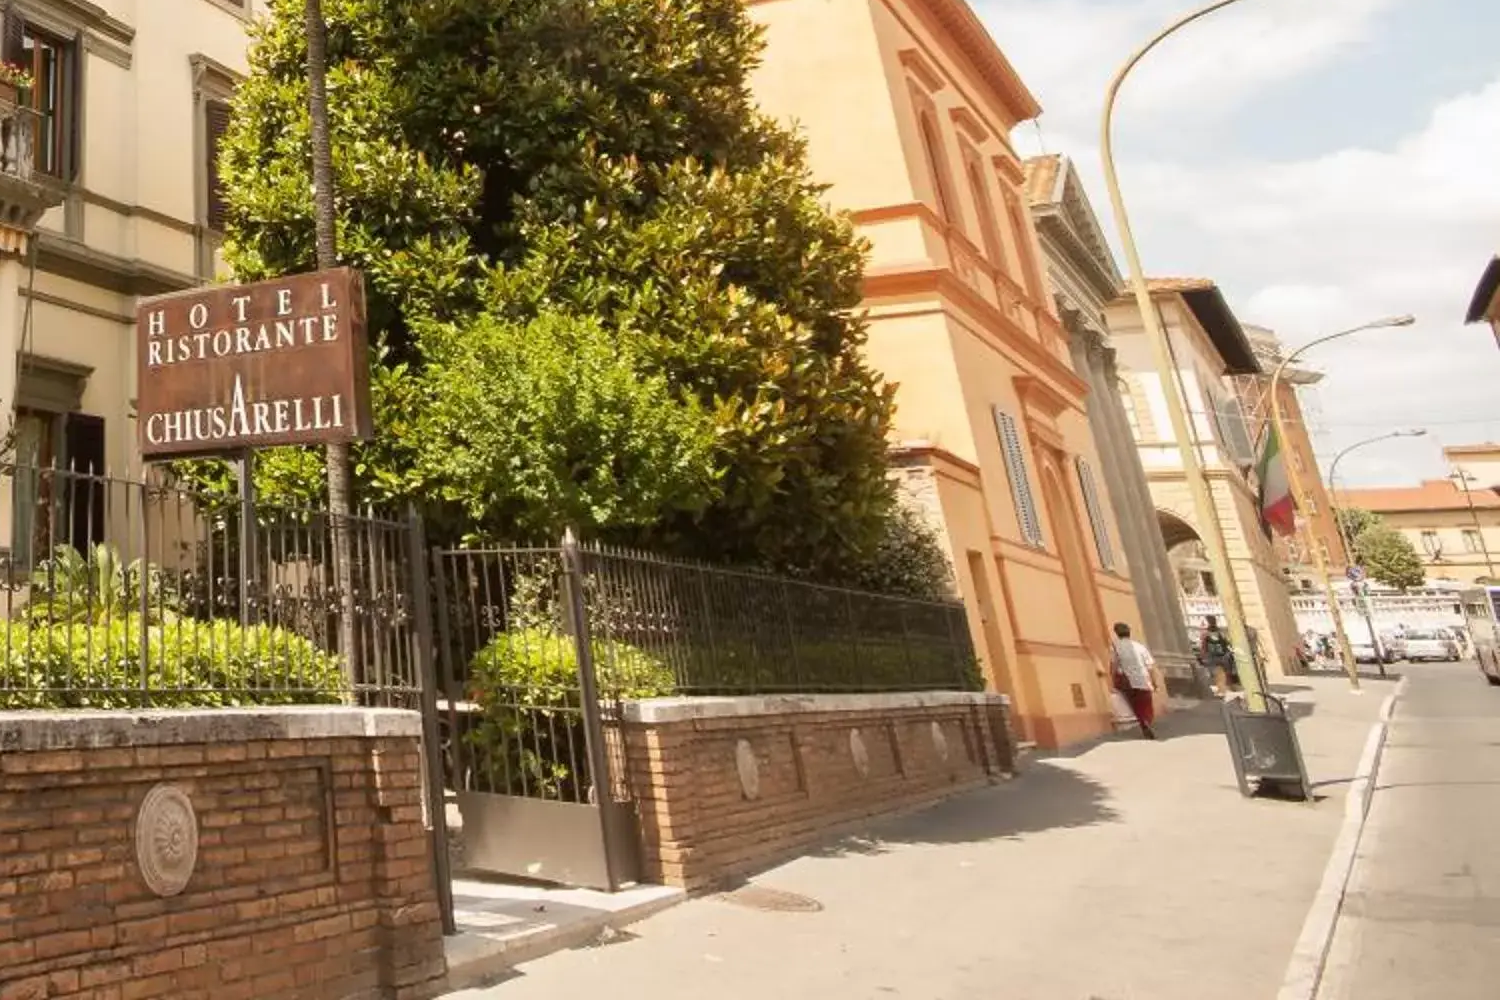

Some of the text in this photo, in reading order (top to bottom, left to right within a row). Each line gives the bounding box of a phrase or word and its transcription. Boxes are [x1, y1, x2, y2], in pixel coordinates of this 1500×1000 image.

[149, 283, 337, 336] HOTEL
[148, 314, 338, 366] RISTORANTE
[147, 374, 344, 445] CHIUSARELLI
